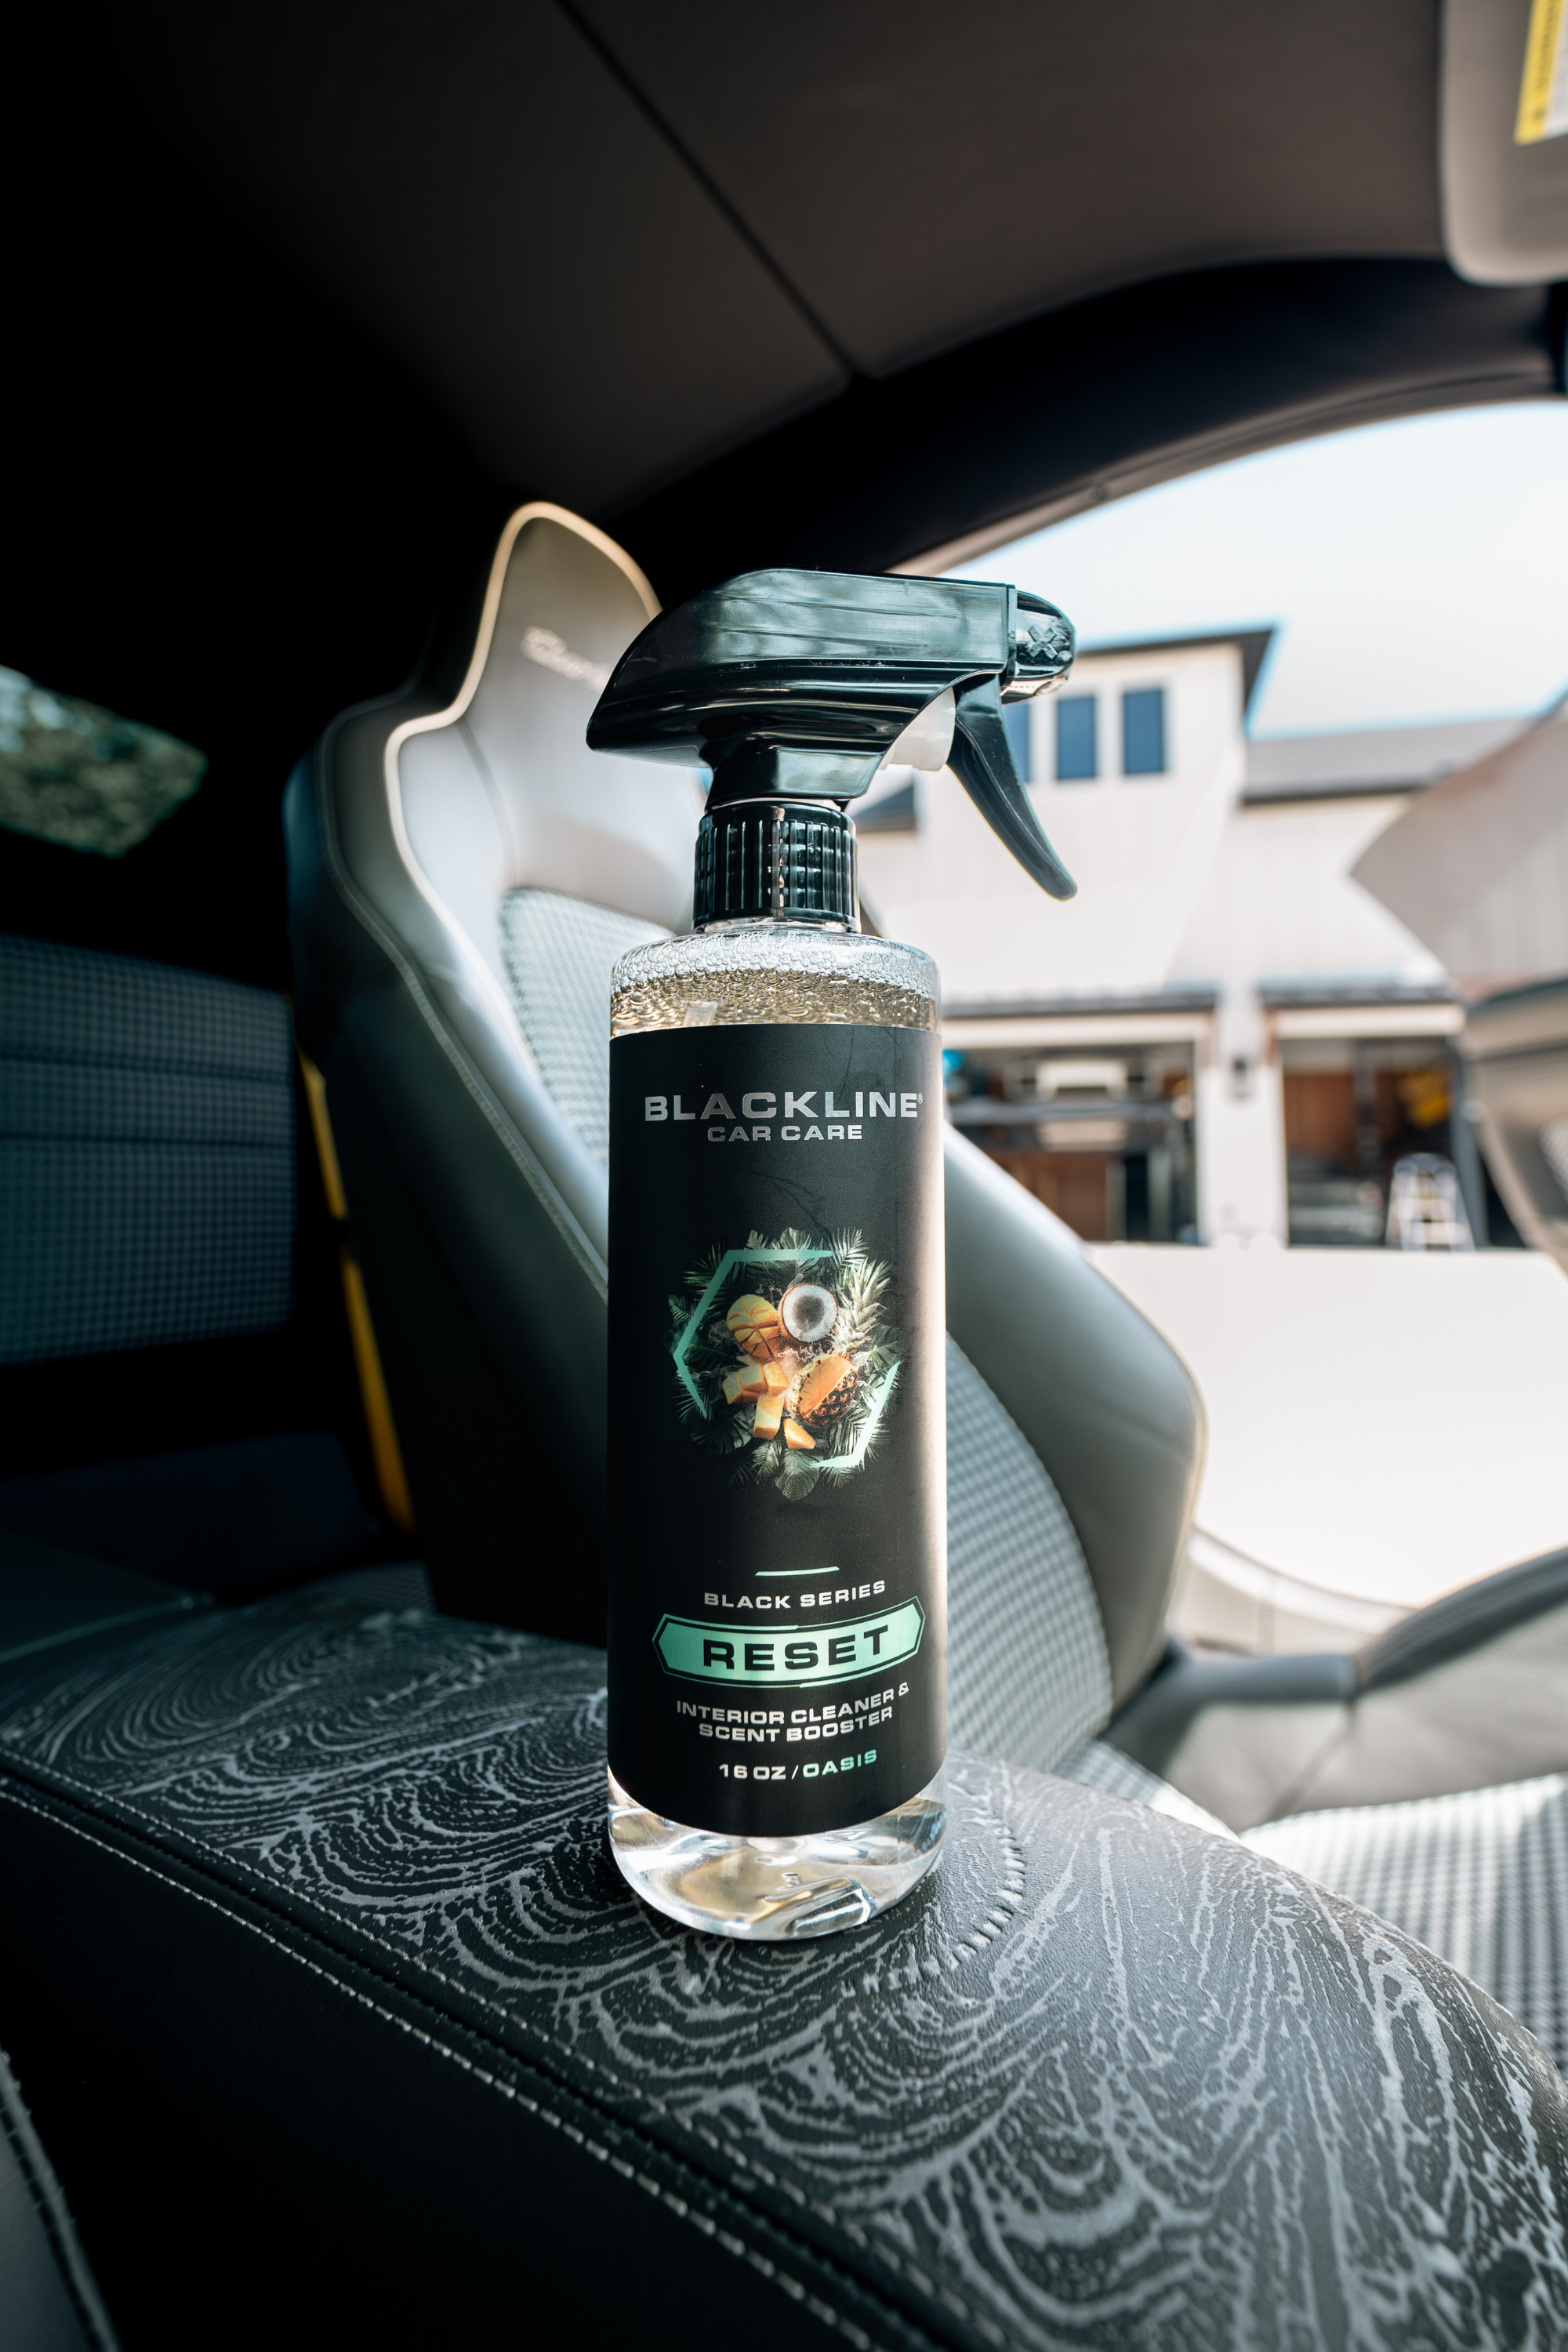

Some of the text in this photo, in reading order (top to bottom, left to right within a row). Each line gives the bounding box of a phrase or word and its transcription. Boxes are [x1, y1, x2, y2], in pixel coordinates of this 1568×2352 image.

[707, 1124, 862, 1142] CAR CARE
[704, 1580, 886, 1609] BLACK SERIES
[702, 1624, 889, 1671] RESET
[677, 1682, 909, 1725] INTERIOR CLEANER &
[699, 1706, 893, 1743] SCENT BOOSTER
[719, 1763, 748, 1780] 16
